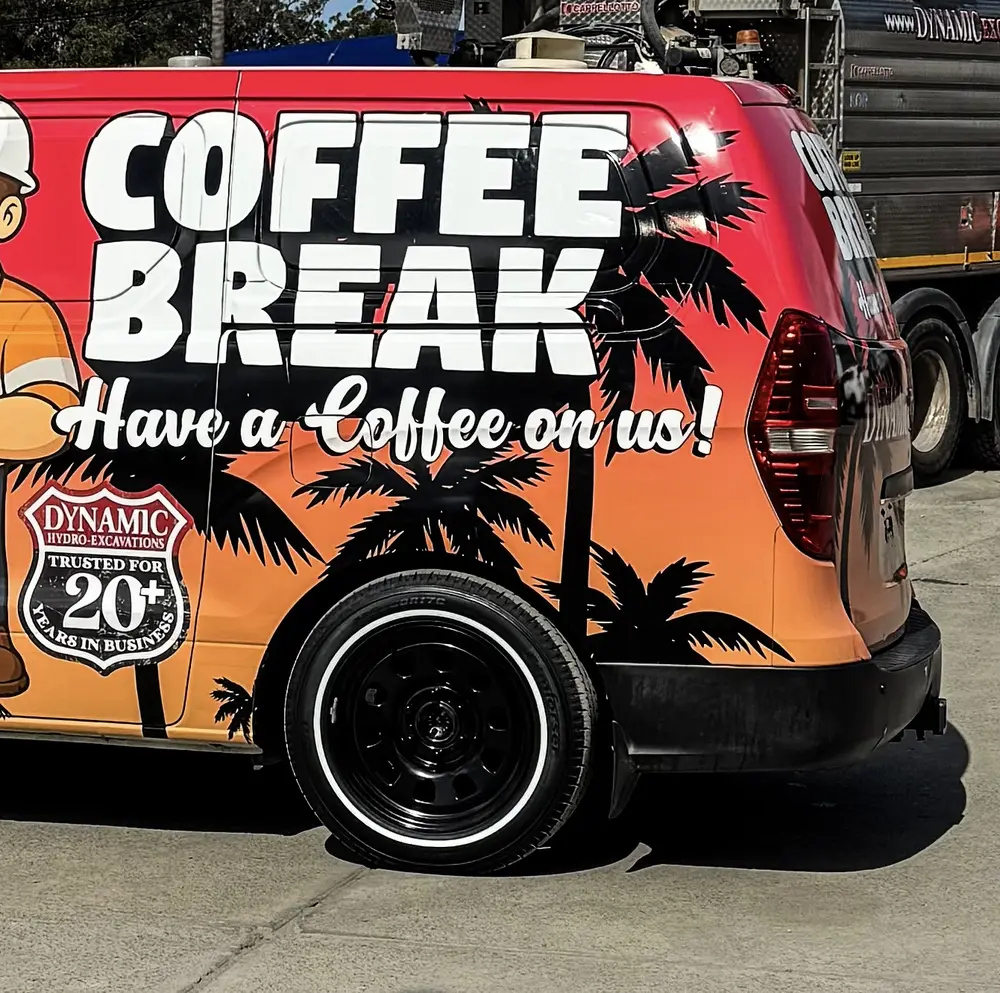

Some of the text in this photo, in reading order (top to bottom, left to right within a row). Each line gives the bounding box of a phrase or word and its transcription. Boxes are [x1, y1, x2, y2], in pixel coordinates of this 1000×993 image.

[573, 0, 640, 14] CAPPELLOTTO
[82, 110, 629, 238] COFFEE
[83, 240, 604, 376] BREAK
[56, 374, 723, 463] Have a Coffee on us!
[44, 502, 169, 537] DYNAMIC
[47, 532, 165, 550] HYDRO-EXCAVATIONS
[48, 554, 164, 574] TRUSTED FOR
[32, 602, 175, 653] YEARS IN BUSINESS
[62, 572, 165, 633] 20+
